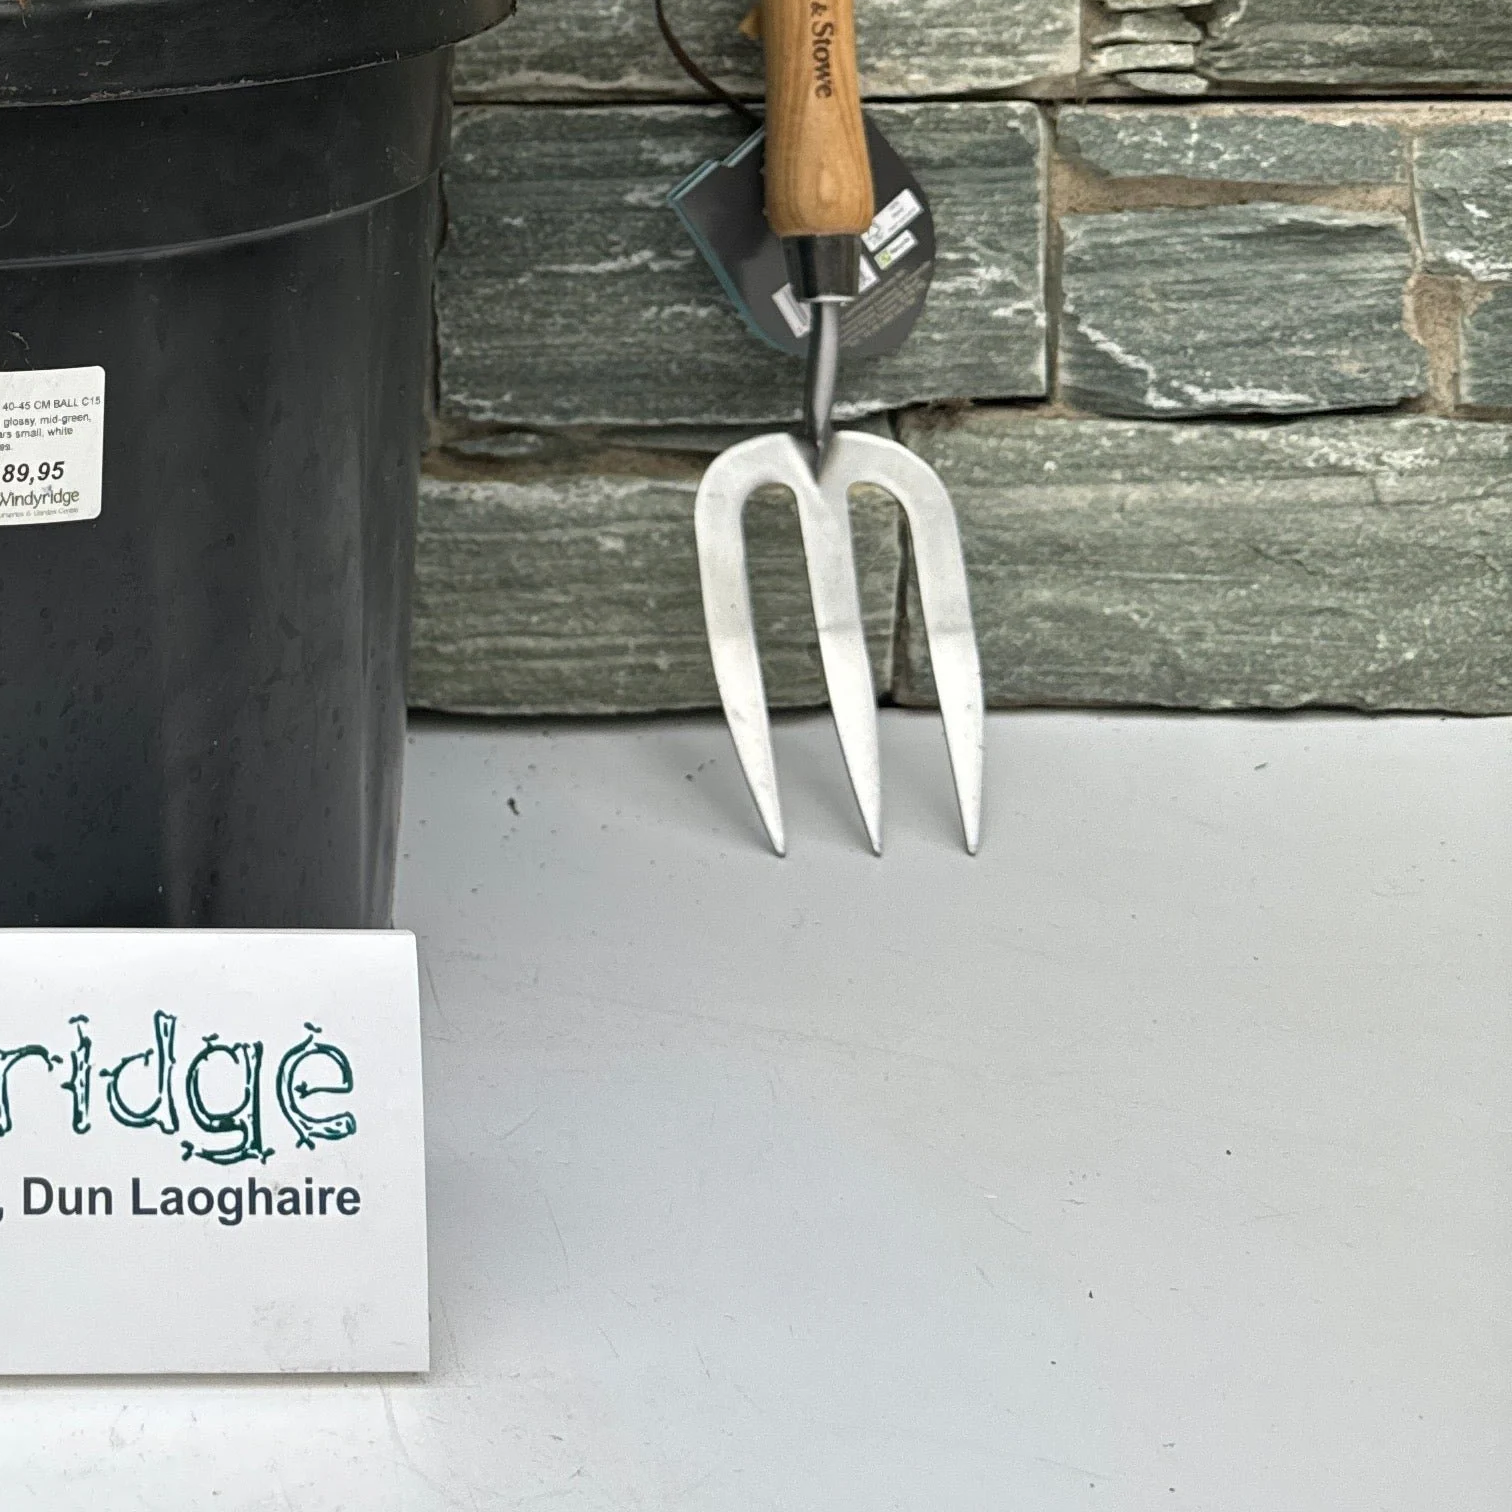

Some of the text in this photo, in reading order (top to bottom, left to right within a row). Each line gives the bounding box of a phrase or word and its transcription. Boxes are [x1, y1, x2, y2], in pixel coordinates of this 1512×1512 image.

[810, 1, 828, 17] &
[811, 20, 835, 100] Stowe
[2, 395, 101, 411] 40-45 CM BALL C15
[47, 426, 74, 437] white
[1, 460, 65, 486] 89,95
[23, 1177, 113, 1216] Dun
[132, 1177, 361, 1226] Laoghaire
